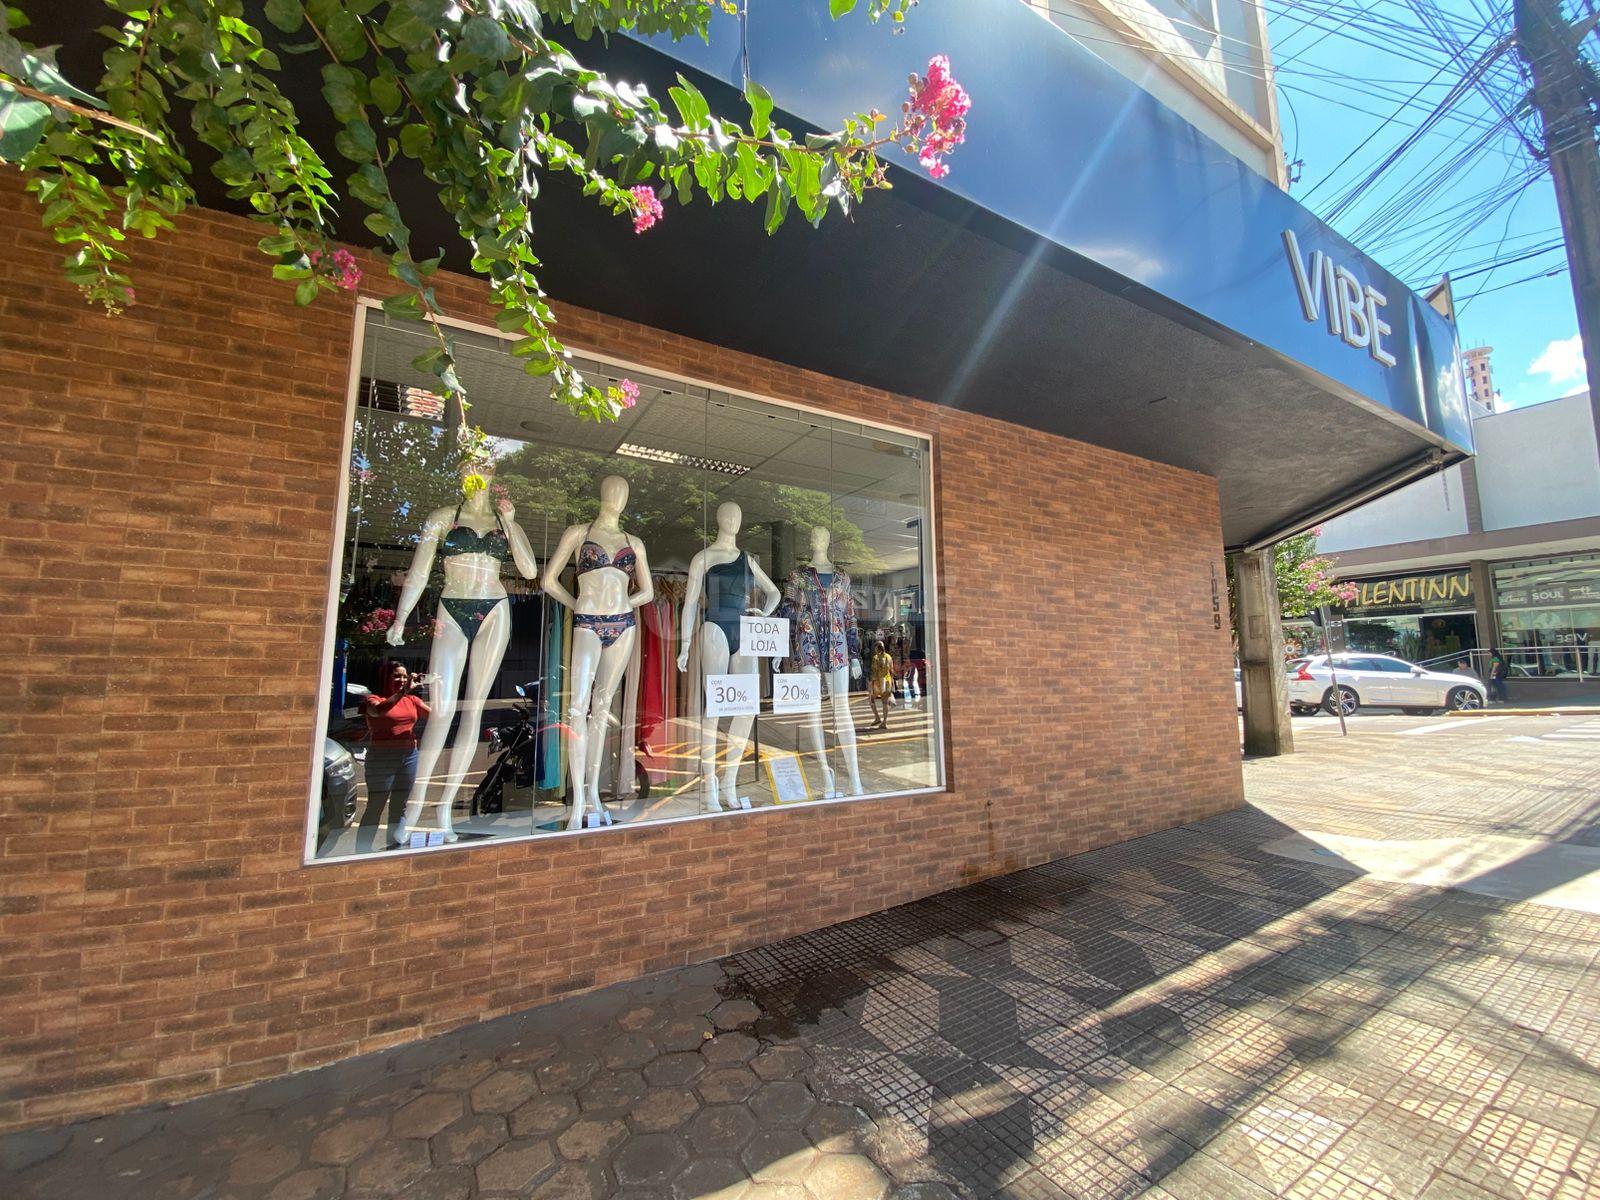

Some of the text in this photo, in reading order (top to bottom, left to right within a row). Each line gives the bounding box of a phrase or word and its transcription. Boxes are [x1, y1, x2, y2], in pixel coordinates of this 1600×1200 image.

[1281, 229, 1396, 368] VIBE
[1335, 573, 1469, 608] LENTINN
[747, 622, 779, 635] TODA
[750, 640, 777, 652] LOJA
[715, 686, 748, 703] 30%
[781, 685, 810, 701] 20%
